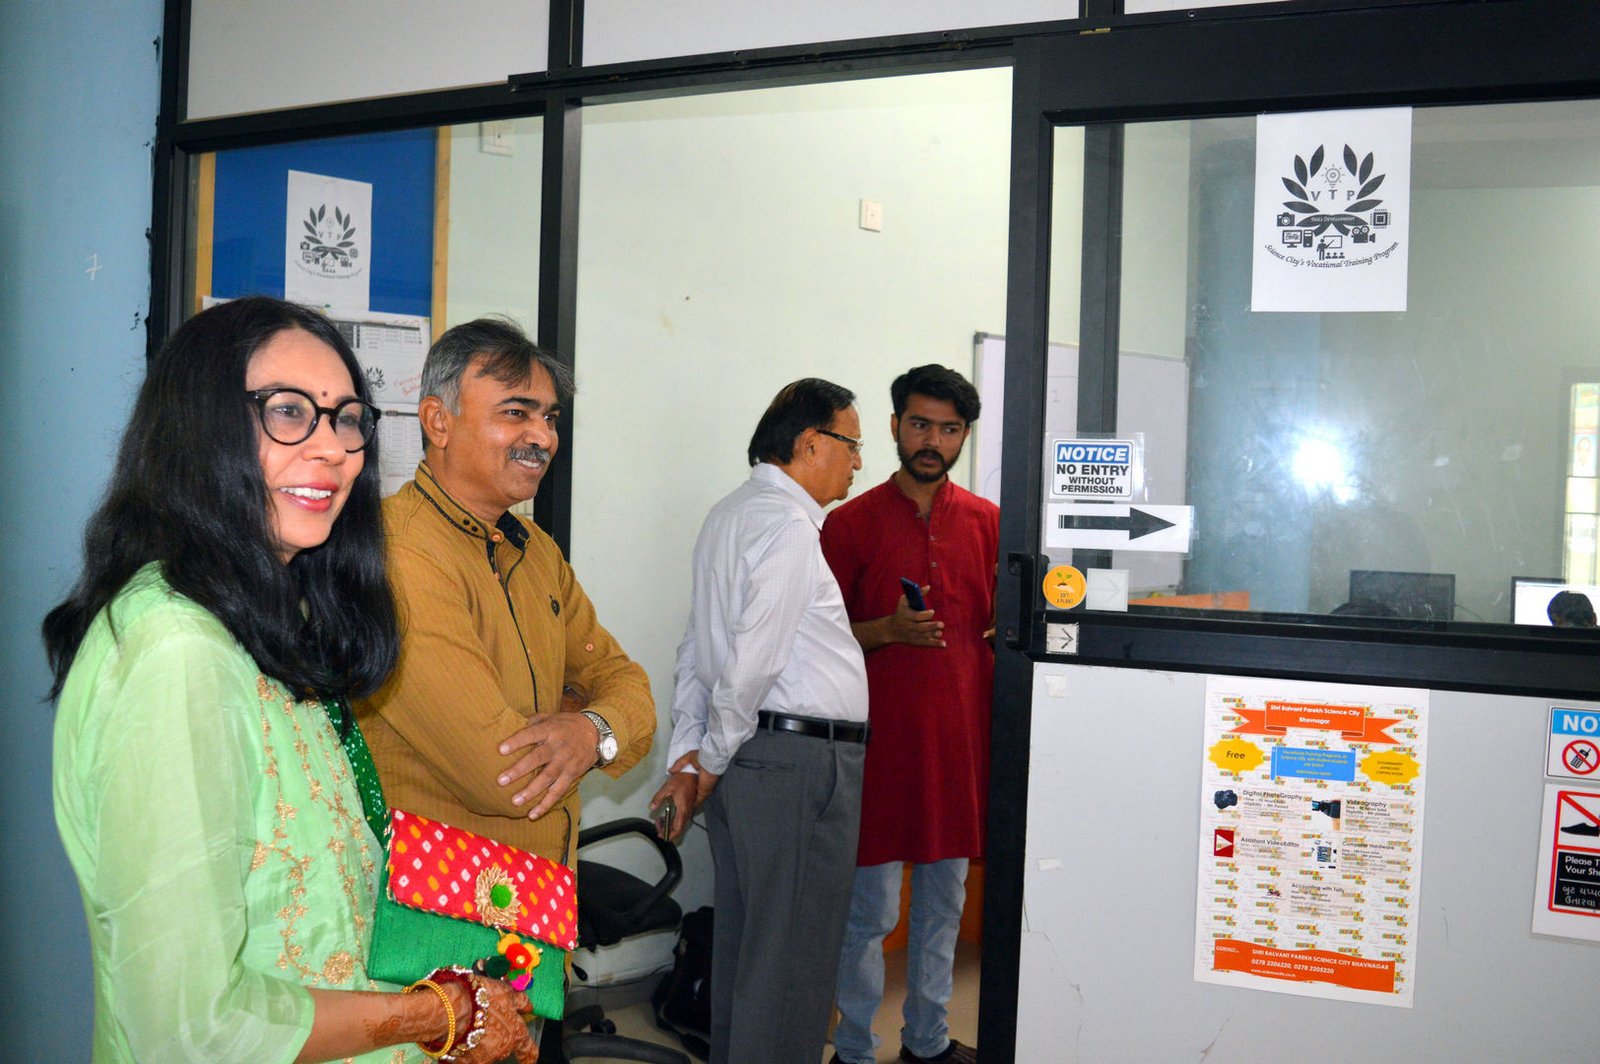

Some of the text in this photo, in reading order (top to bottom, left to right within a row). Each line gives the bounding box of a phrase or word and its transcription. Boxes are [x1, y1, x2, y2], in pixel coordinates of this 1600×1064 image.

[1265, 244, 1284, 260] Science
[1306, 259, 1342, 268] Vocational
[1343, 256, 1373, 267] Training
[1373, 242, 1399, 260] Program
[1058, 446, 1128, 462] NOTICE
[1056, 464, 1129, 476] NO ENTRY
[1068, 476, 1116, 485] WITHOUT
[1061, 485, 1123, 494] PERMISSION
[1563, 713, 1600, 733] NO
[1226, 750, 1246, 759] Free
[1346, 799, 1387, 808] Videography
[1565, 855, 1592, 866] Please
[1565, 865, 1587, 875] Your
[1265, 950, 1290, 958] BALVANT
[1313, 956, 1337, 965] SCIENCE
[1351, 961, 1389, 970] BHAVNAGAR
[1293, 963, 1309, 971] 0278
